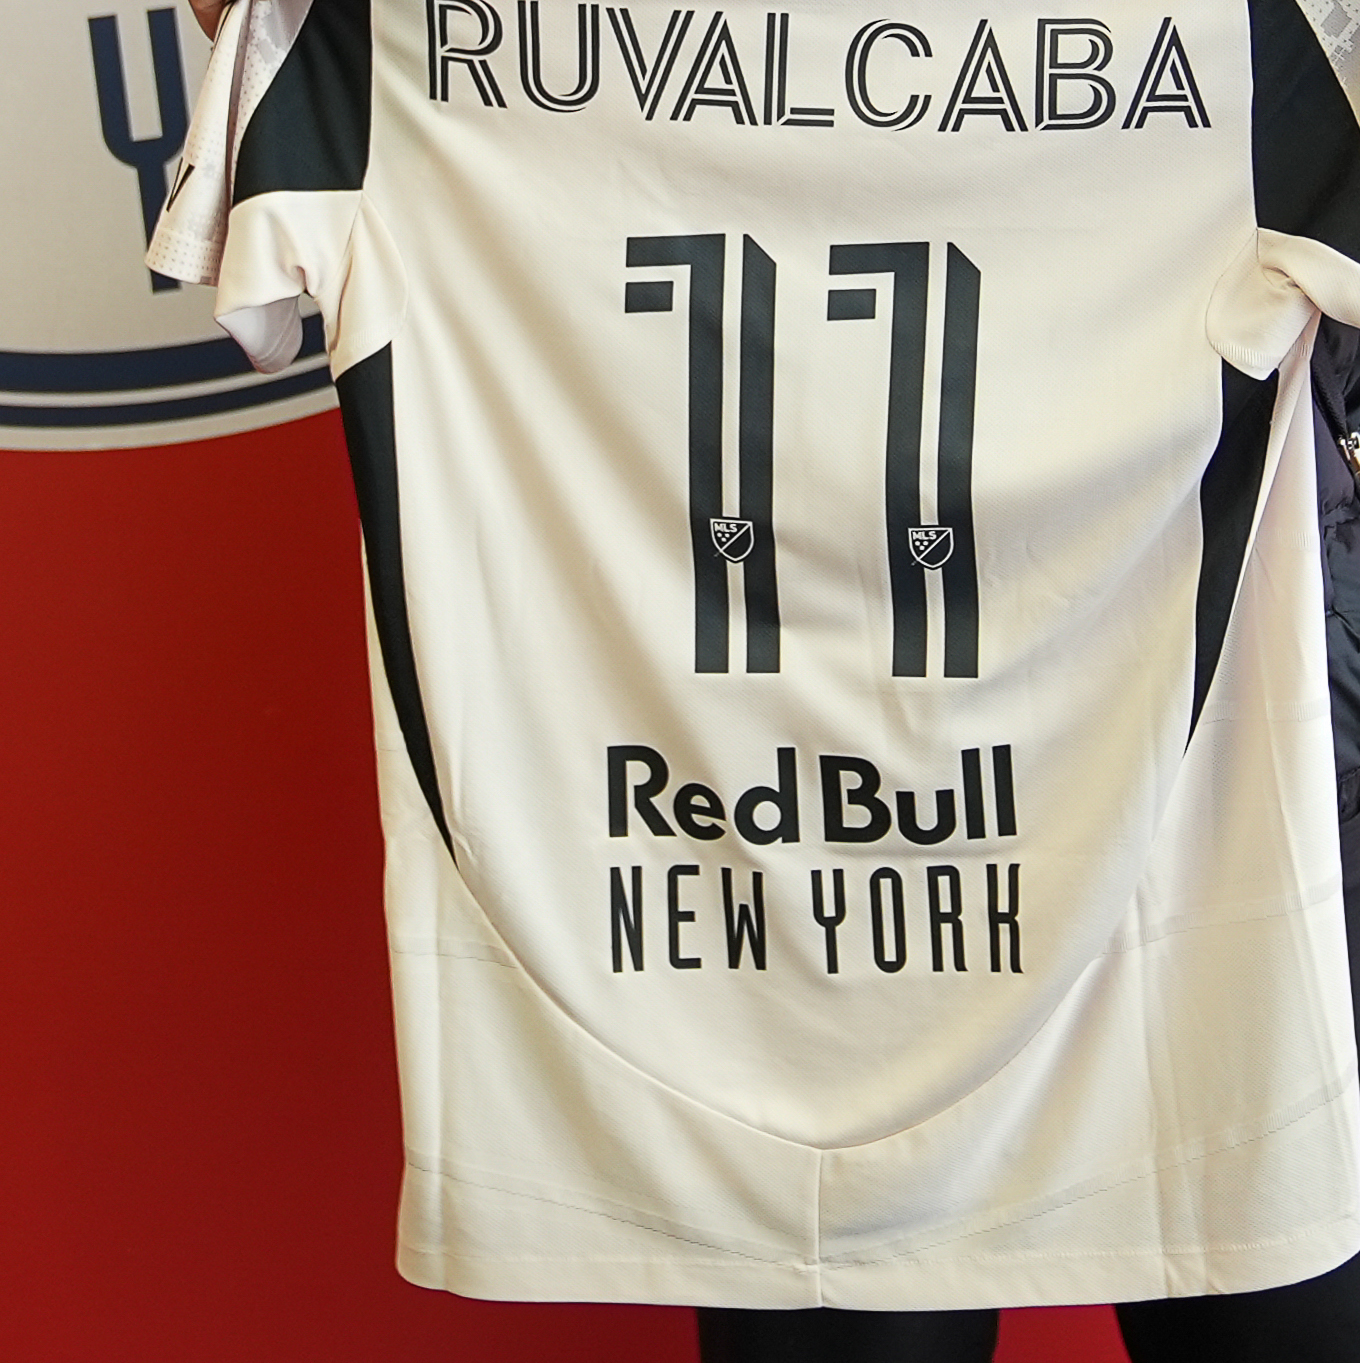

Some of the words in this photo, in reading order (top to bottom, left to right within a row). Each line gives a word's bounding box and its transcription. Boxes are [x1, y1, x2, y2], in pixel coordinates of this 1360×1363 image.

[624, 233, 982, 679] 11
[714, 522, 738, 533] MLS
[912, 530, 937, 541] MLS
[606, 744, 801, 846] Red
[818, 743, 1018, 846] Bull
[609, 864, 767, 974] NEW
[810, 863, 1025, 975] YORK
